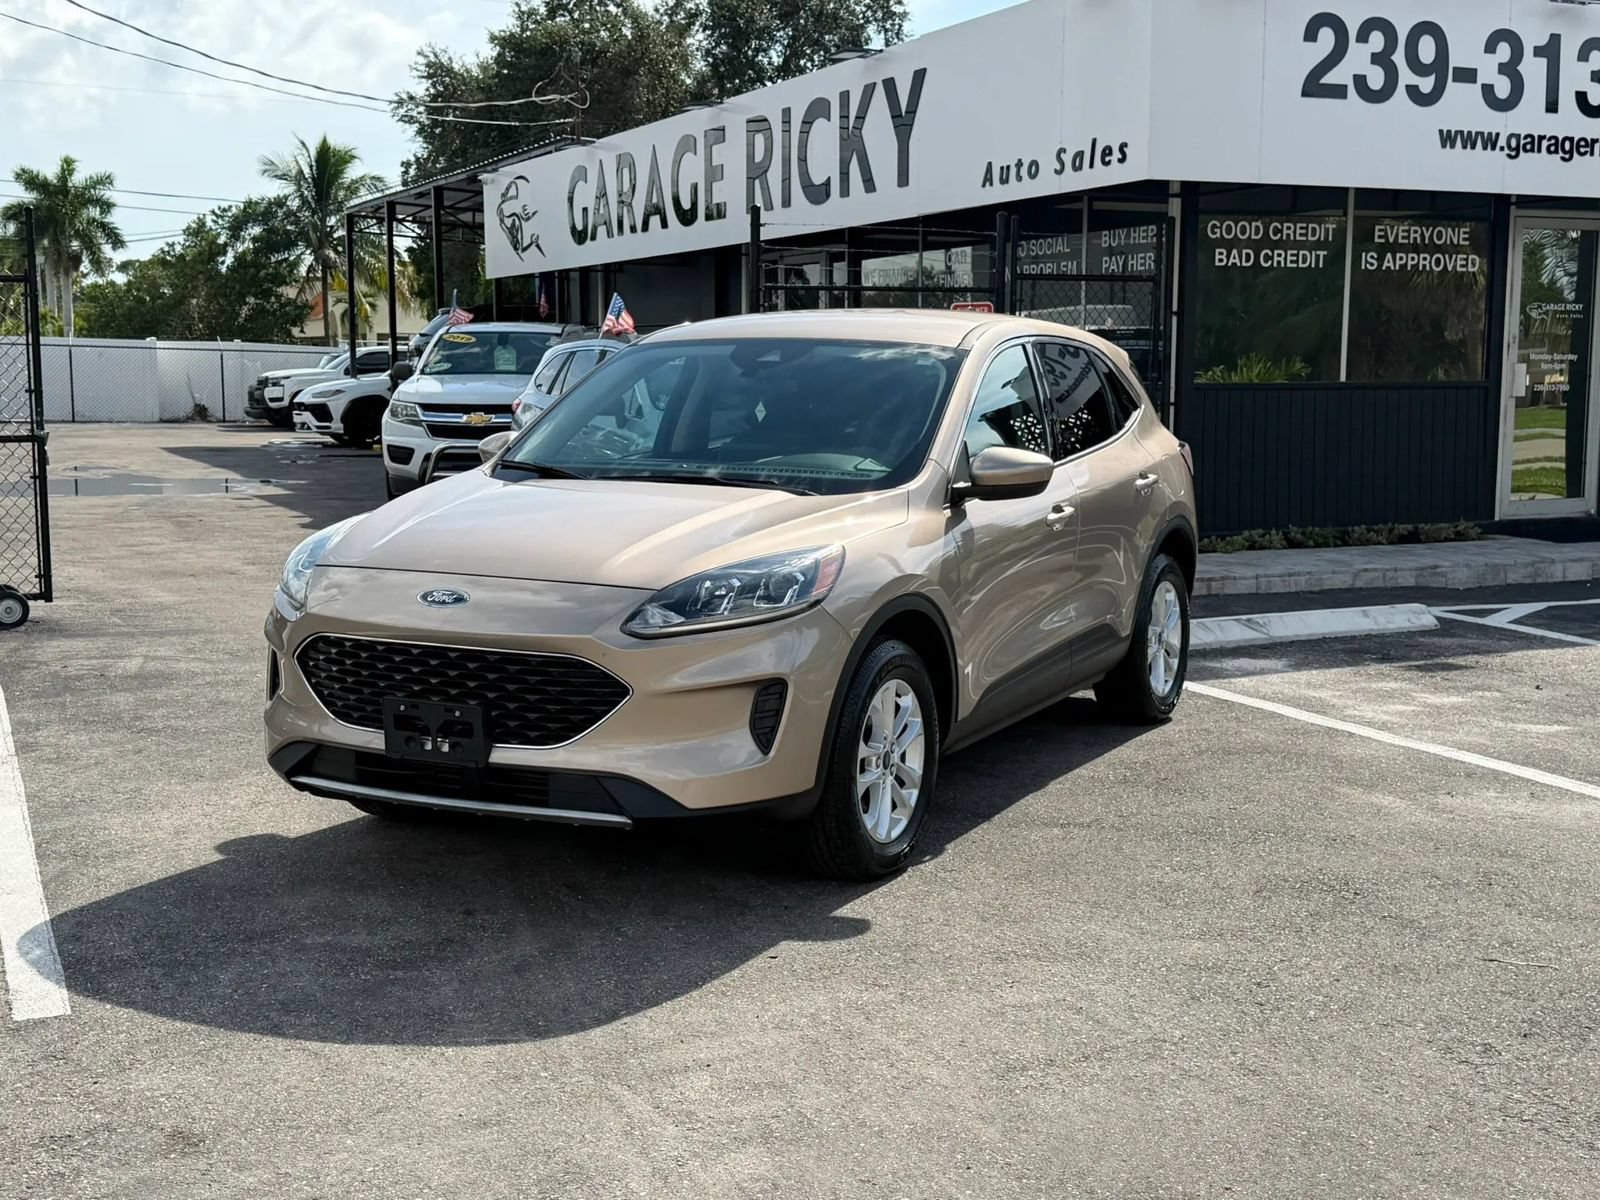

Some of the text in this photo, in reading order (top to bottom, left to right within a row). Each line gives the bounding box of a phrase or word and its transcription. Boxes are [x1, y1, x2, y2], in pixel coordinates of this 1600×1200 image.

[1301, 12, 1600, 118] 239-313
[567, 67, 927, 246] GARAGE RICKY
[1438, 129, 1600, 162] www.garager
[981, 137, 1128, 188] Auto Sales
[1101, 223, 1166, 248] BUY HER
[1207, 220, 1337, 242] GOOD CREDIT
[1374, 224, 1470, 246] EVERYONE
[1029, 235, 1071, 256] SOCIAL
[1102, 253, 1155, 275] PAY HER
[1214, 248, 1328, 268] BAD CREDIT
[1361, 252, 1480, 272] IS APPROVED
[427, 590, 458, 603] Ford
